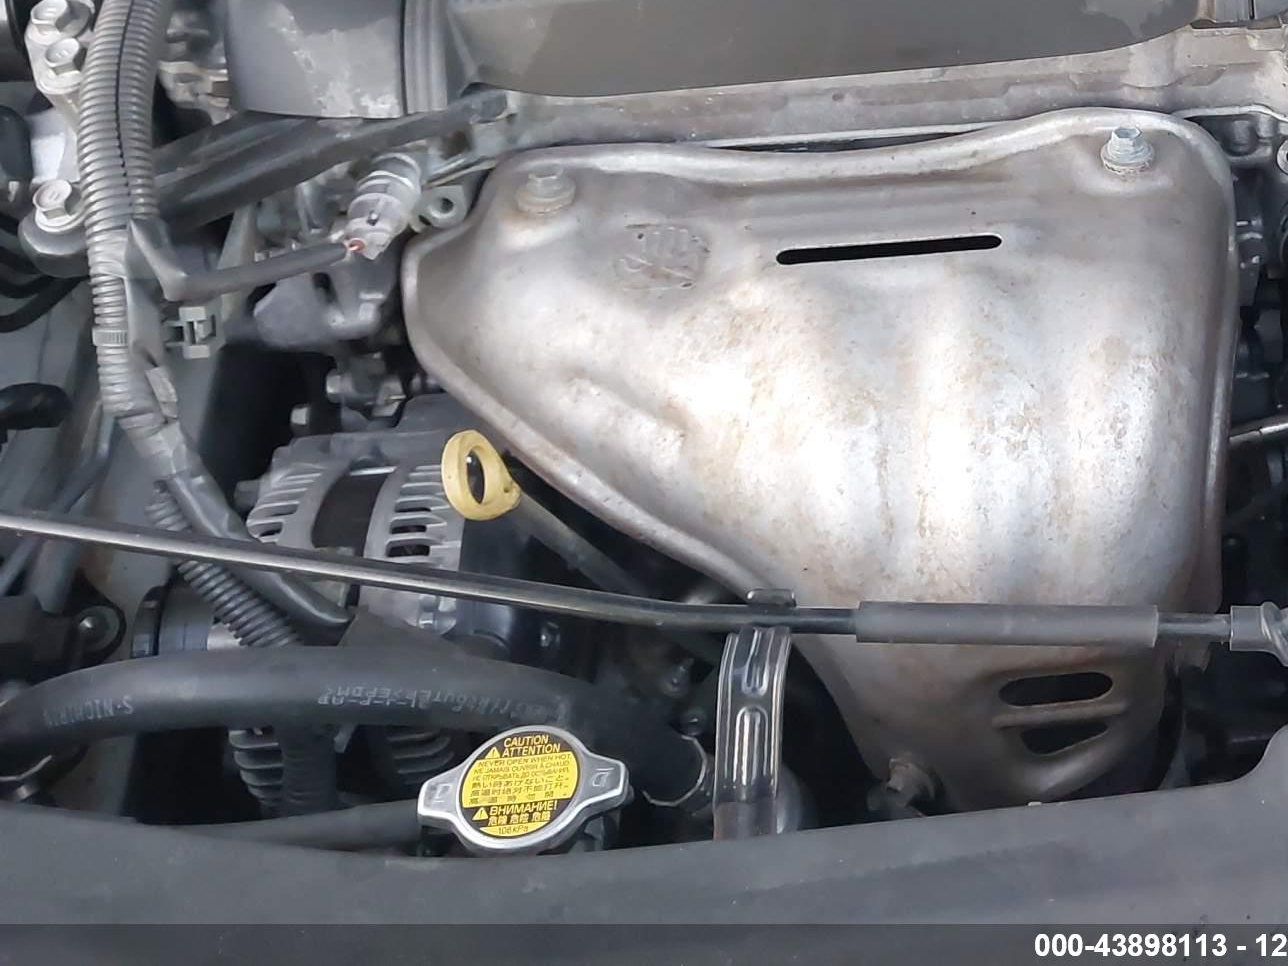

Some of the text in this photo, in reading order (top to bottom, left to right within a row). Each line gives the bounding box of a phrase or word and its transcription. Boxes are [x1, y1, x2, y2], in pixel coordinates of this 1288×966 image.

[503, 734, 549, 748] CAUTION
[501, 743, 561, 758] ATTENTION
[479, 753, 572, 768] NEVER OPEN WHEN HOT
[489, 800, 558, 815] ВНИМАНИЕ!
